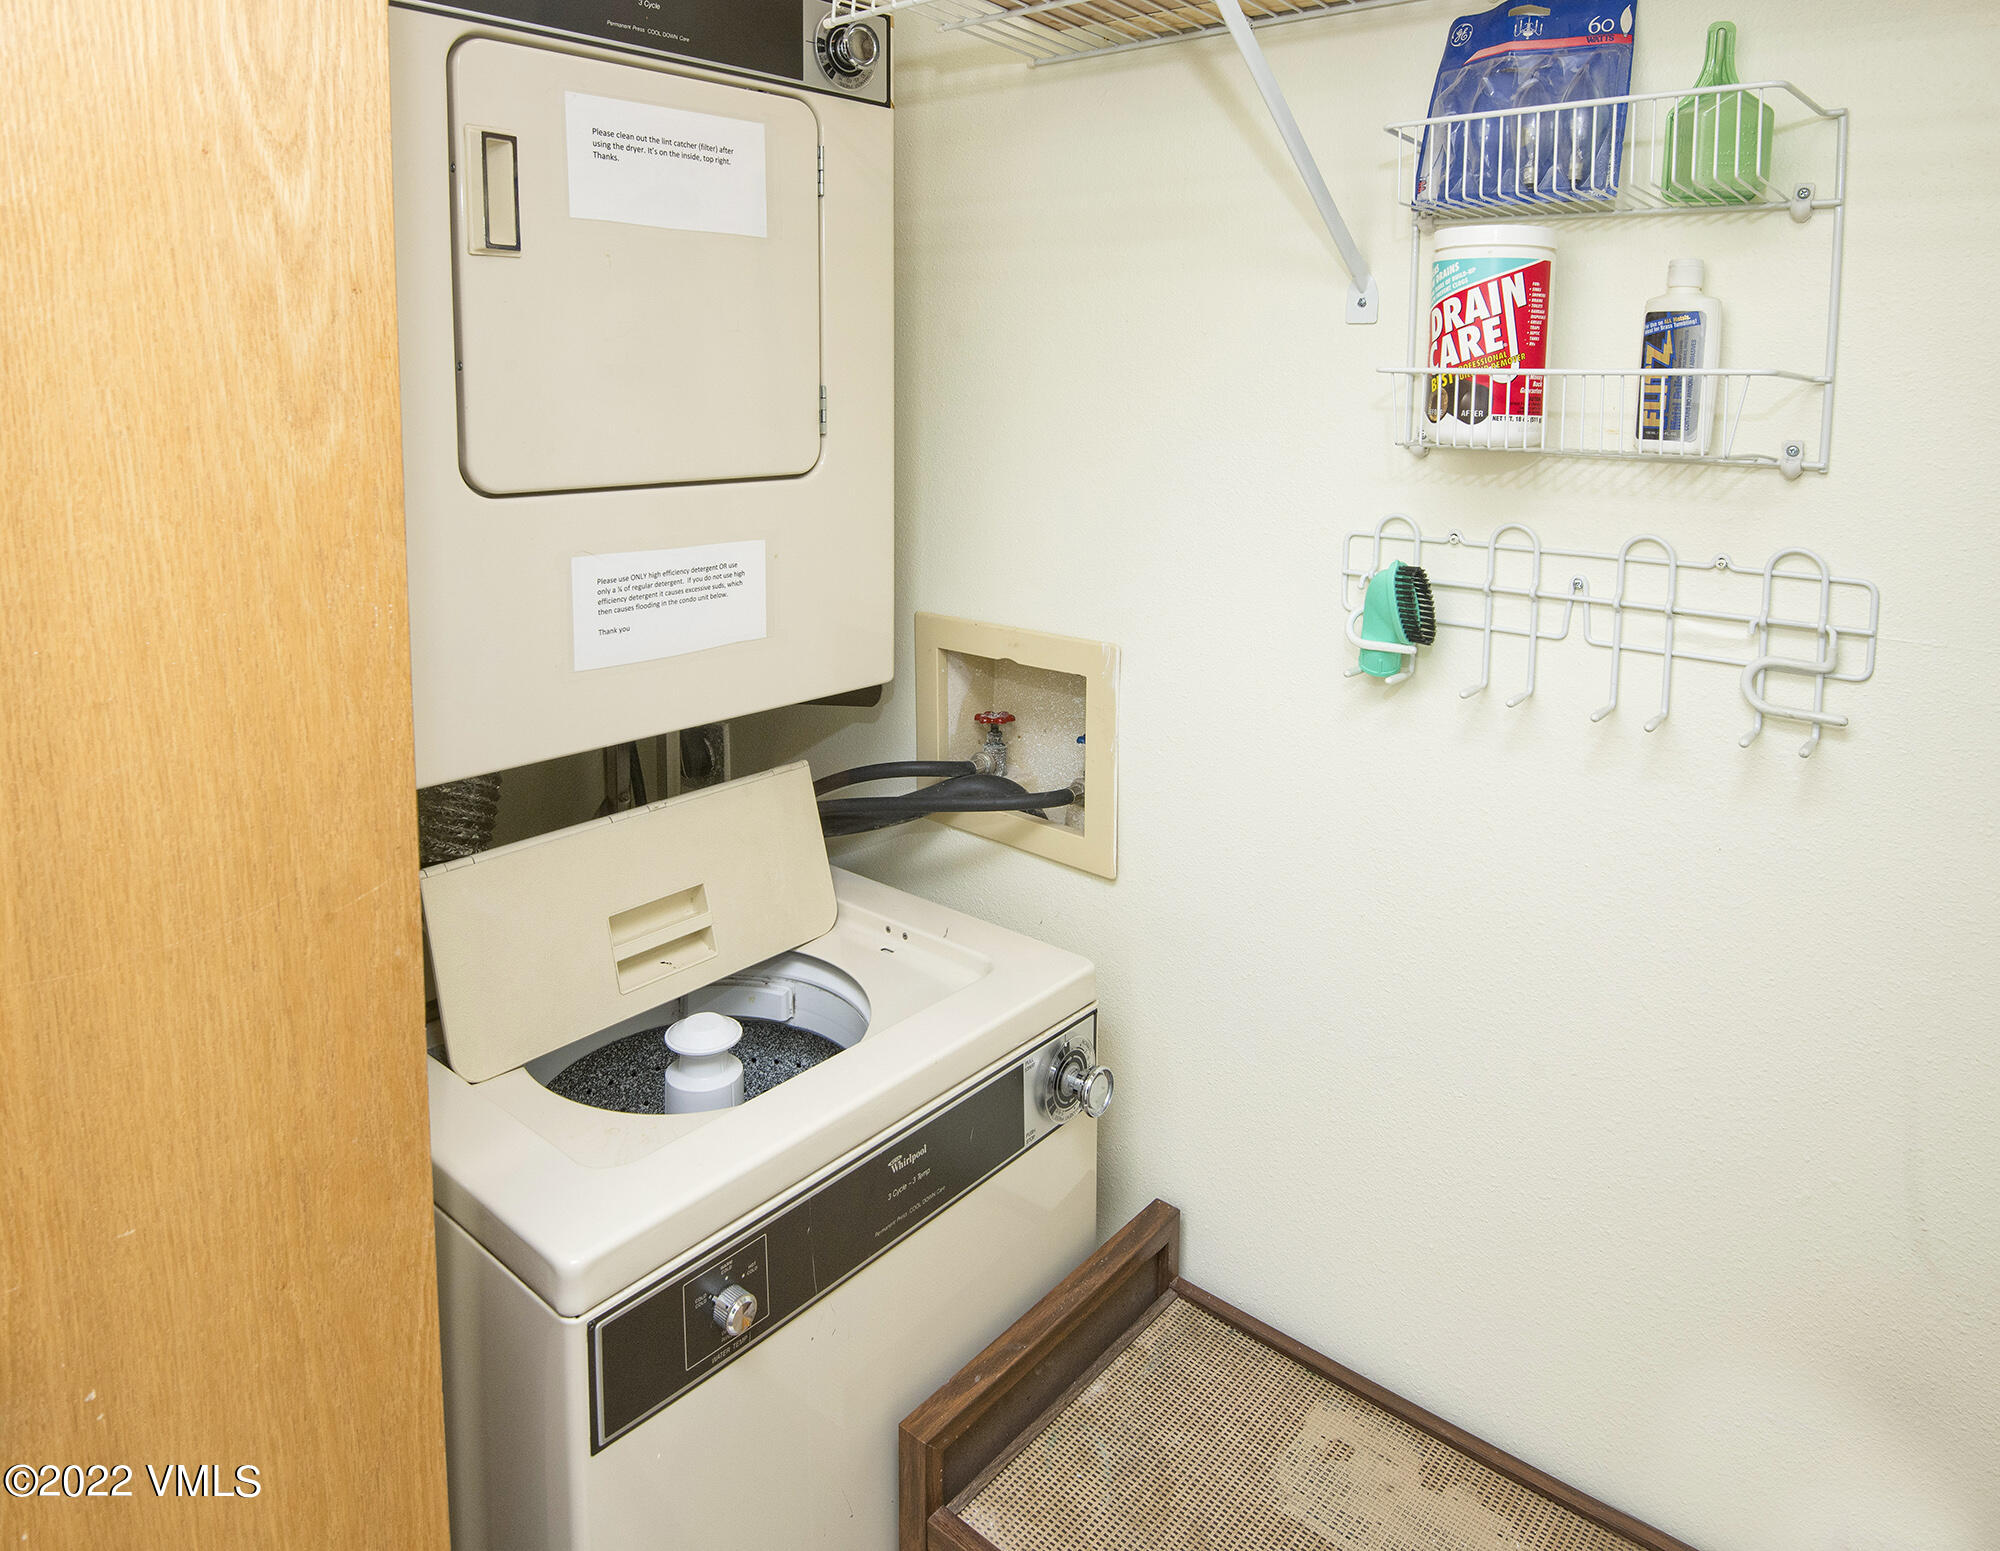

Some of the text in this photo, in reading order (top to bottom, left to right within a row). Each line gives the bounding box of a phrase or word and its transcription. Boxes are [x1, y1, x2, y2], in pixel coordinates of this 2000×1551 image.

[643, 0, 661, 10] Cycle
[606, 19, 631, 30] Permanent
[632, 25, 645, 33] Press
[647, 28, 661, 37] COOL
[662, 31, 678, 40] DOWN
[1587, 15, 1615, 35] 60
[1586, 34, 1615, 44] WATTS
[592, 127, 734, 154] Please clean out the lint catcher (filter) after
[592, 140, 611, 150] using
[612, 142, 624, 151] the
[625, 143, 646, 154] dryer.
[647, 146, 658, 155] It's
[669, 150, 680, 158] the
[681, 151, 702, 162] inside,
[702, 155, 714, 164] top
[714, 156, 731, 165] right.
[592, 151, 620, 162] Thanks.
[1431, 271, 1528, 343] DRAIN
[1430, 316, 1504, 370] CARE
[1459, 351, 1508, 368] OFESSIONAL
[1491, 352, 1526, 369] REMOVER
[1431, 374, 1453, 392] BST
[1461, 409, 1484, 418] AFER
[597, 577, 617, 586] Please
[630, 573, 647, 581] ONLY
[648, 571, 661, 580] high
[662, 569, 690, 578] efficiency
[690, 564, 718, 574] detergent
[718, 562, 728, 570] OR
[597, 587, 611, 596] only
[631, 582, 653, 592] regular
[654, 578, 684, 588] detergent.
[733, 570, 746, 579] high
[597, 579, 743, 606] efficiency detergent it causes excessive suds, which
[597, 592, 729, 616] then causes flooding in the condo unit below.
[597, 625, 631, 636] Thank you
[890, 1143, 927, 1173] Whirlpool
[893, 1183, 908, 1198] Cycle
[711, 1346, 731, 1364] WATER
